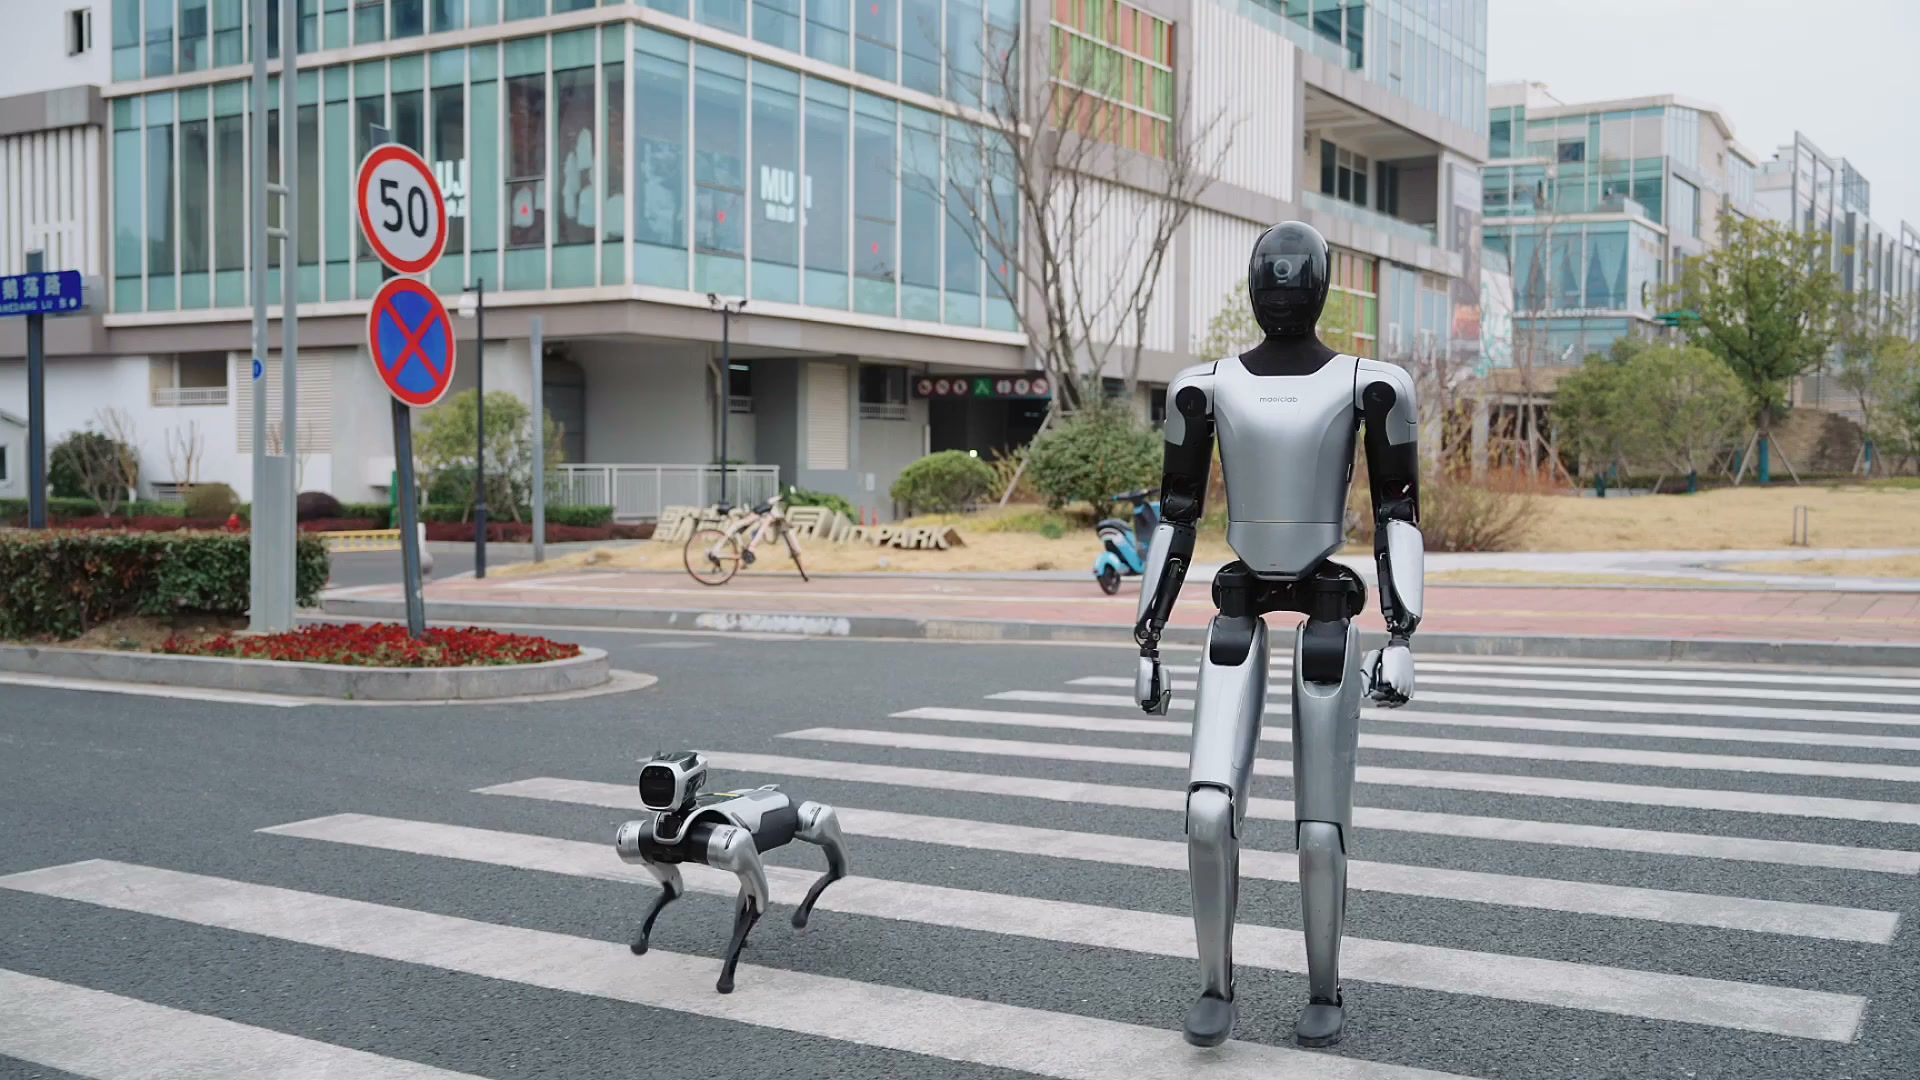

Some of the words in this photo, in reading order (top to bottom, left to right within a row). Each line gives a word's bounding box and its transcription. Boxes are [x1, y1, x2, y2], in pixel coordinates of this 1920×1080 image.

[379, 178, 428, 238] 50
[761, 165, 812, 209] MUI
[873, 526, 950, 550] PARK
